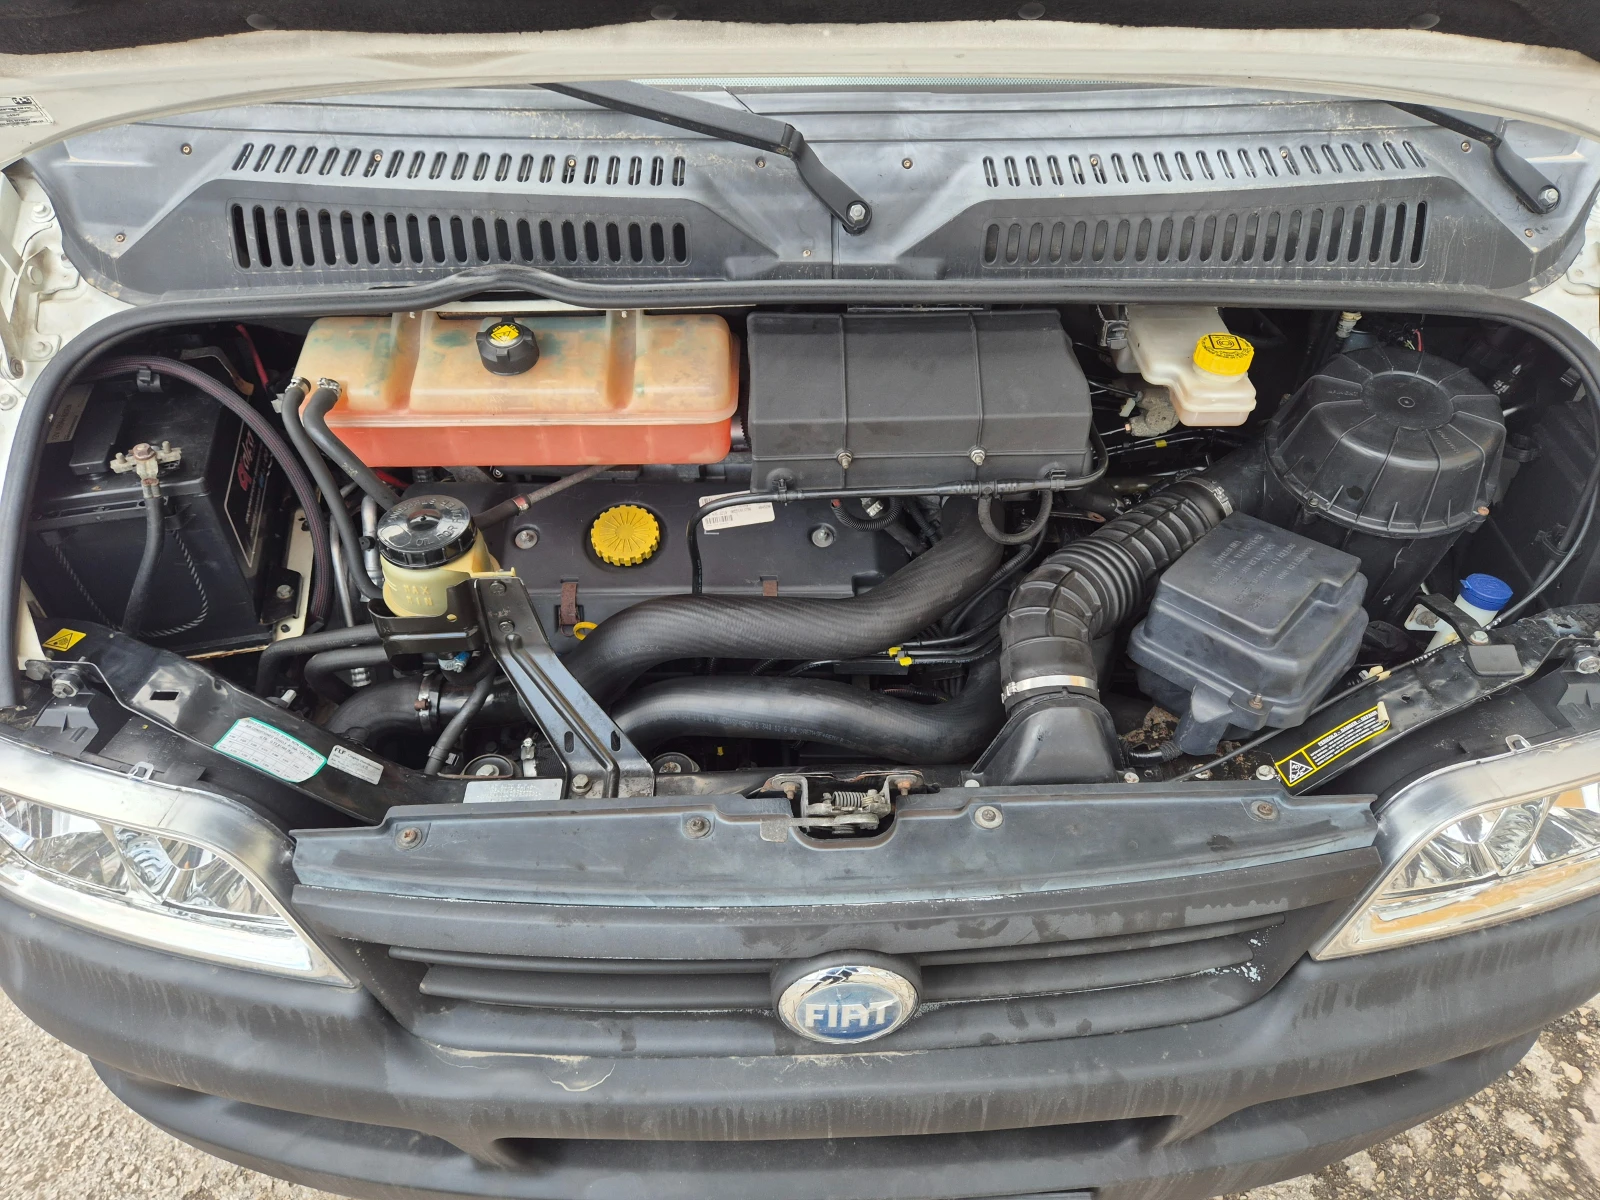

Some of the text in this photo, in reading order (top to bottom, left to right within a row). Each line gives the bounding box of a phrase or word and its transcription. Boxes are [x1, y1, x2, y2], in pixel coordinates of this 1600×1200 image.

[416, 537, 434, 546] OIL
[435, 525, 458, 540] FOR
[403, 584, 430, 595] MAX
[406, 595, 433, 606] MIN
[805, 1001, 893, 1028] FIAT
